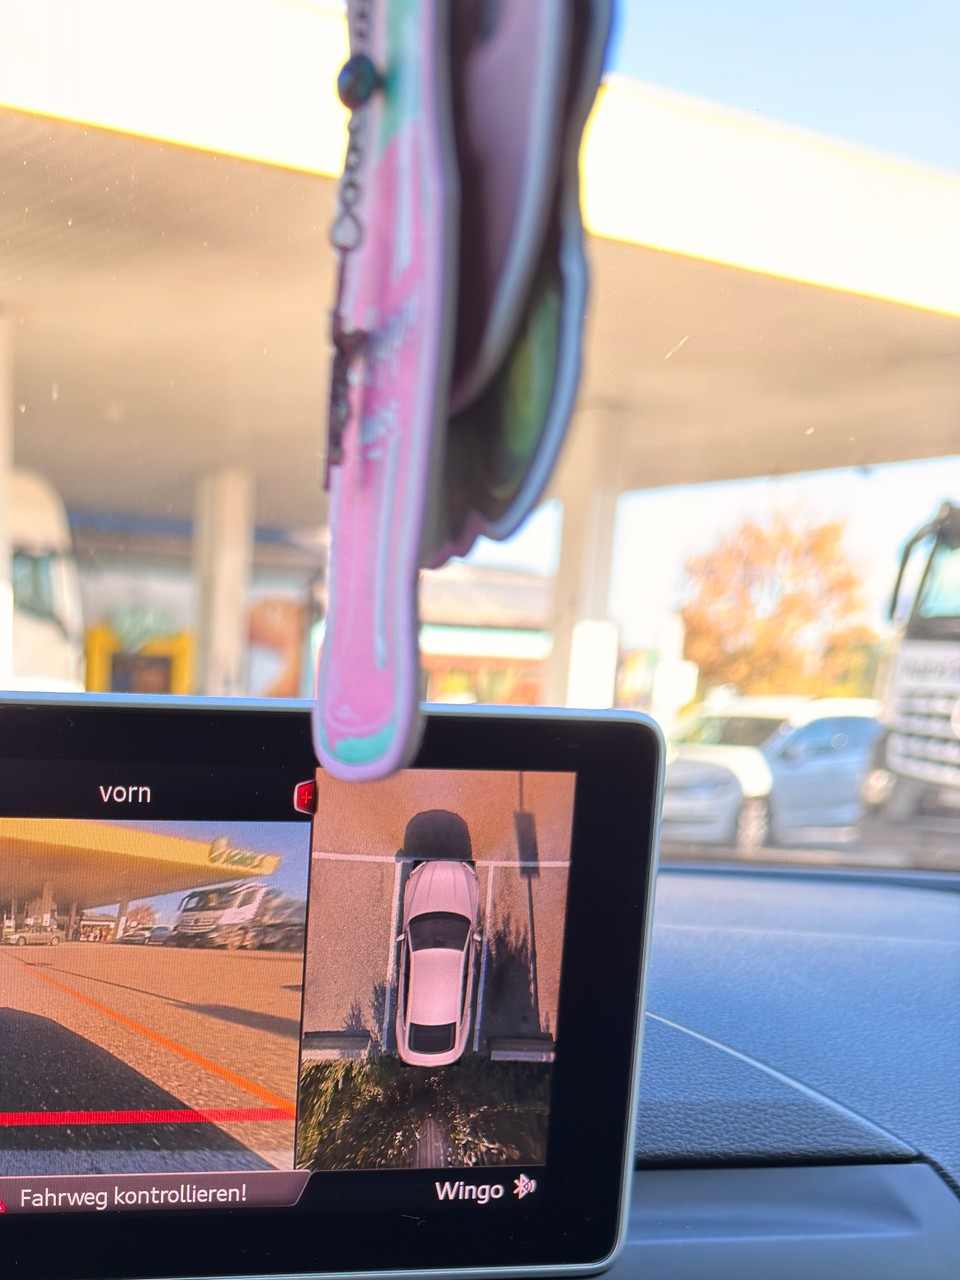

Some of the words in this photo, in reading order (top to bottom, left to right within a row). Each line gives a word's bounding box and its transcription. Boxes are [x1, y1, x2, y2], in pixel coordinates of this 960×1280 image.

[99, 785, 151, 803] vorn
[20, 1189, 108, 1210] Fahrweg
[114, 1184, 247, 1206] kontrollieren!
[435, 1181, 504, 1204] Wingo
